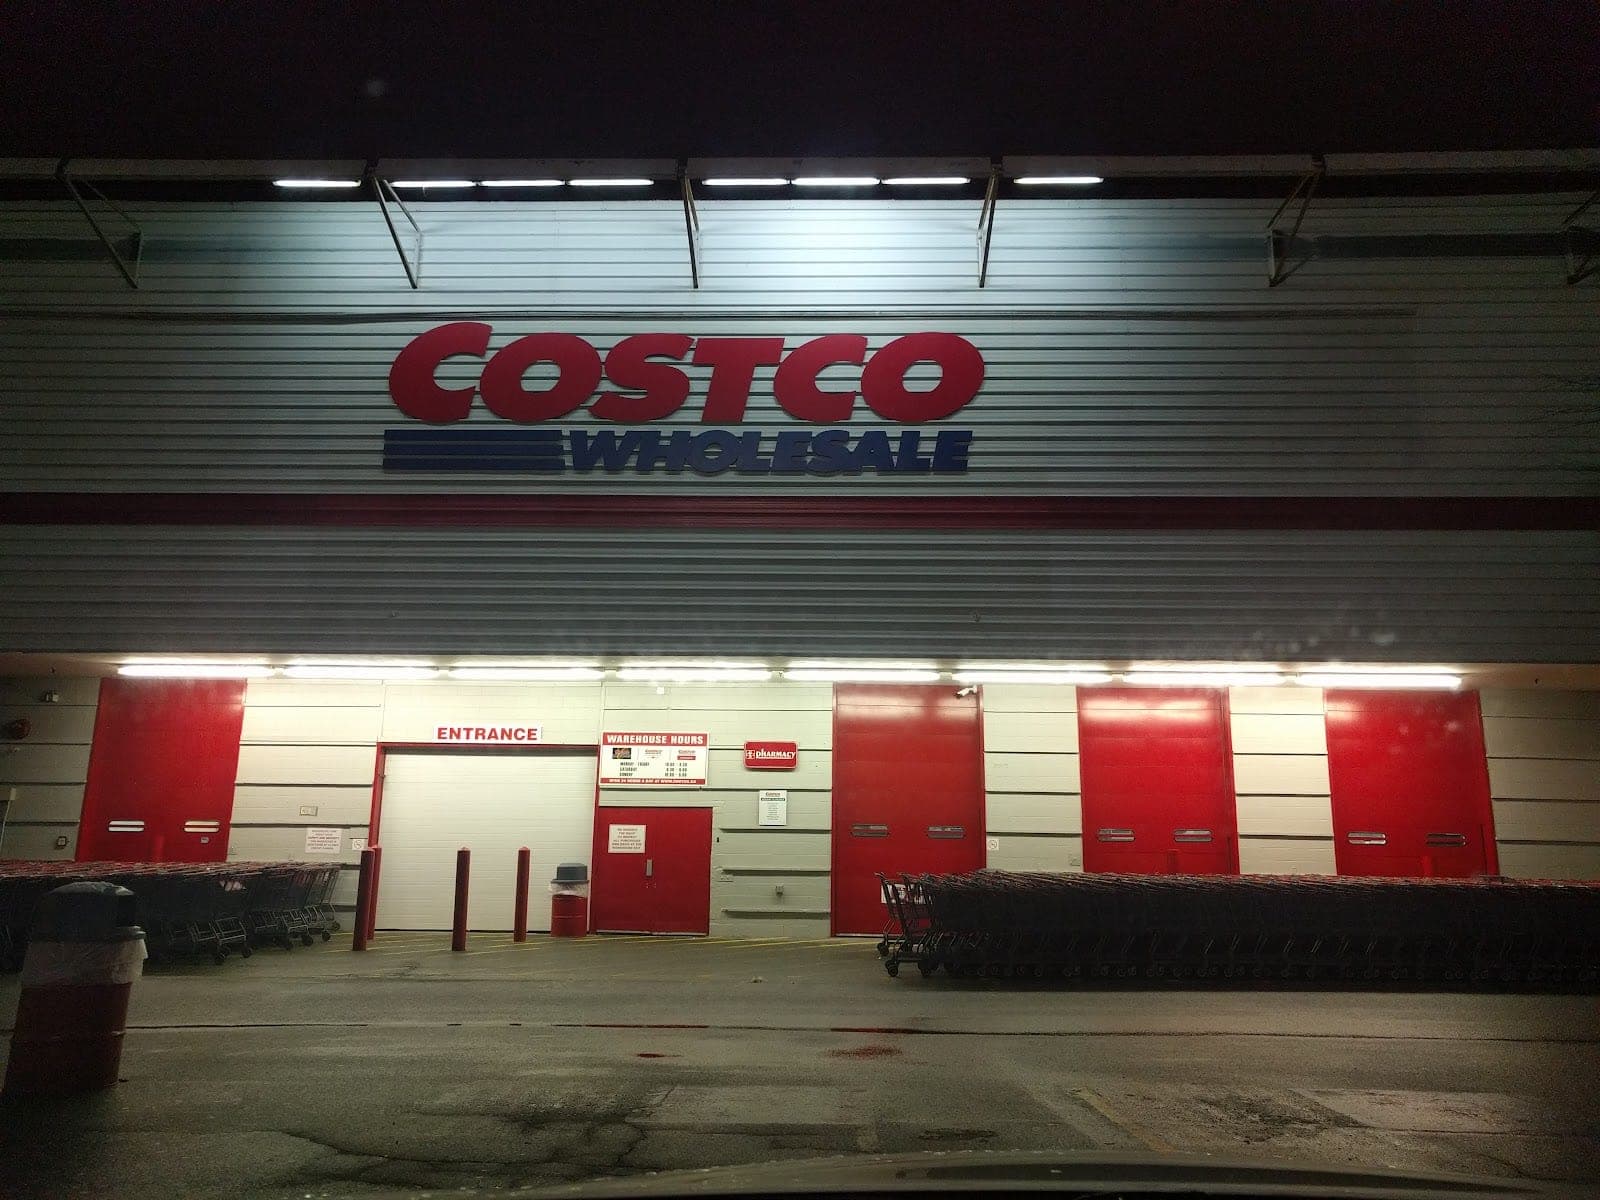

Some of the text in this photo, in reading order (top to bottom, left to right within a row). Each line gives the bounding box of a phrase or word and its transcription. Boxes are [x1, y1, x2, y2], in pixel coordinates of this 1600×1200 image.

[388, 321, 985, 423] COSTCO
[568, 429, 973, 475] WHOLESALE
[437, 727, 538, 741] ENTRANCE
[606, 734, 704, 745] WAREHOUSE HOURS
